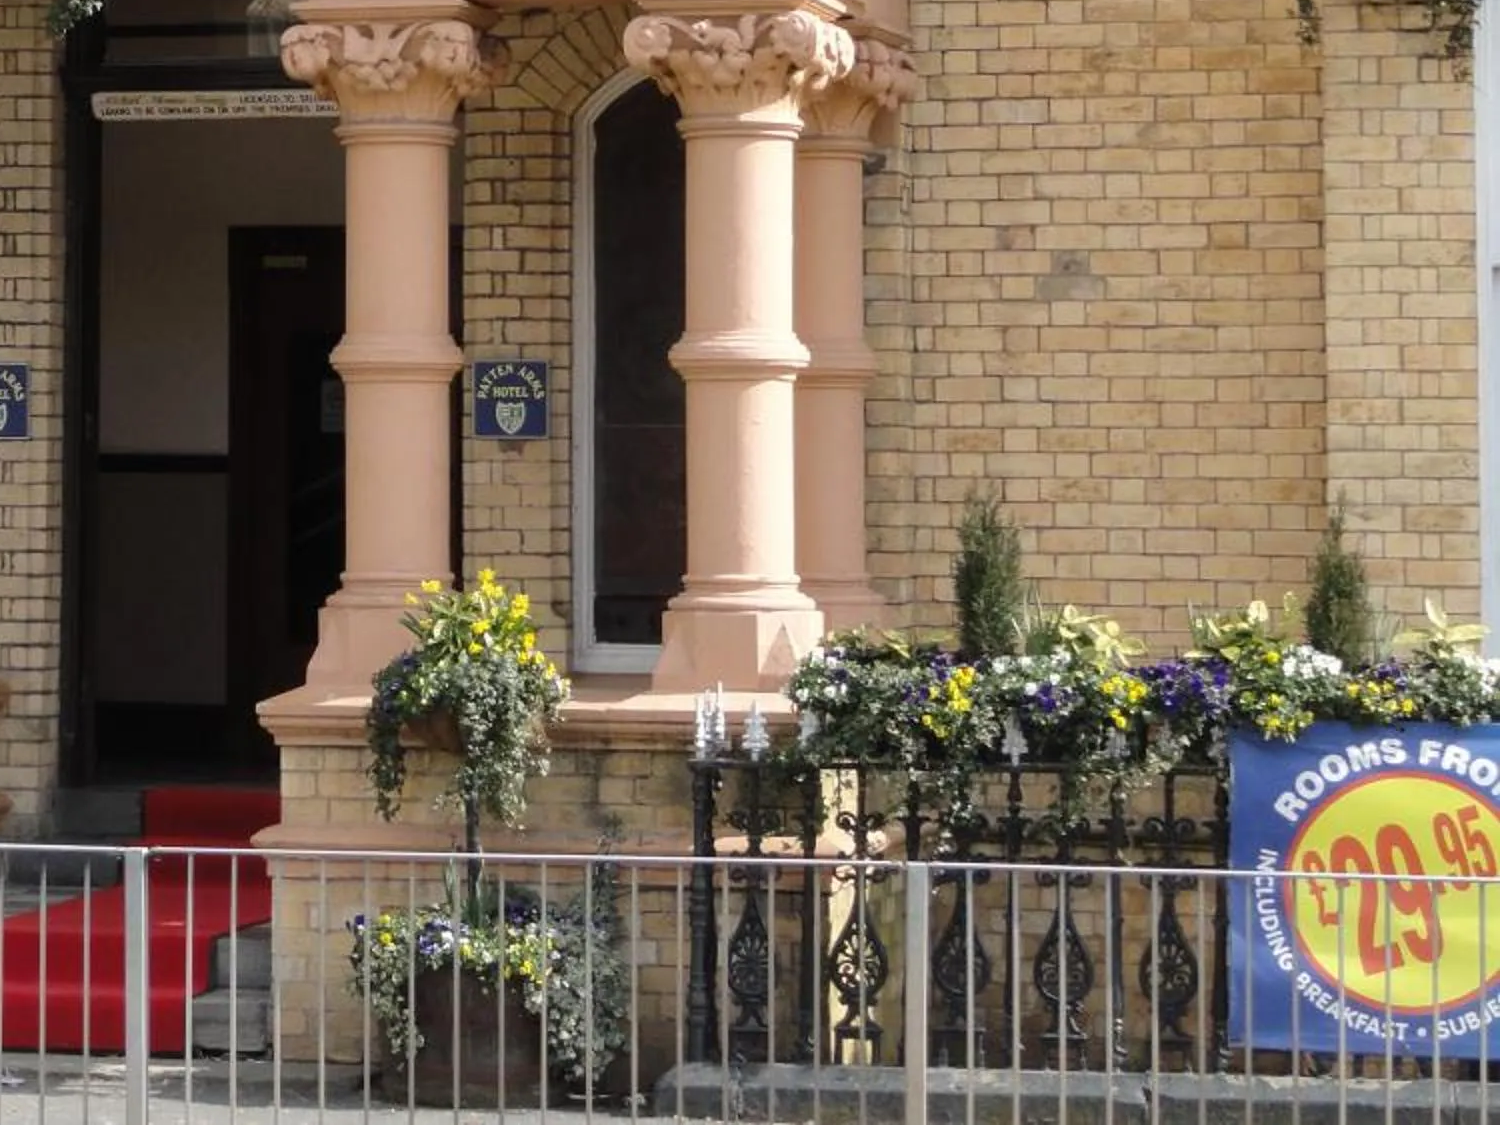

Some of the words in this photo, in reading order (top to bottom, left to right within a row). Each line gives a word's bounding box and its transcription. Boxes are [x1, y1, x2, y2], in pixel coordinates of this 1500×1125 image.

[476, 363, 514, 399] PATTEN
[516, 365, 546, 399] ARMS
[492, 386, 529, 398] HOTEL
[1274, 738, 1407, 823] ROOMS
[1255, 848, 1294, 971] INCLUDING
[1295, 972, 1409, 1042] BREAKFAST
[1436, 993, 1500, 1040] SUBJE
